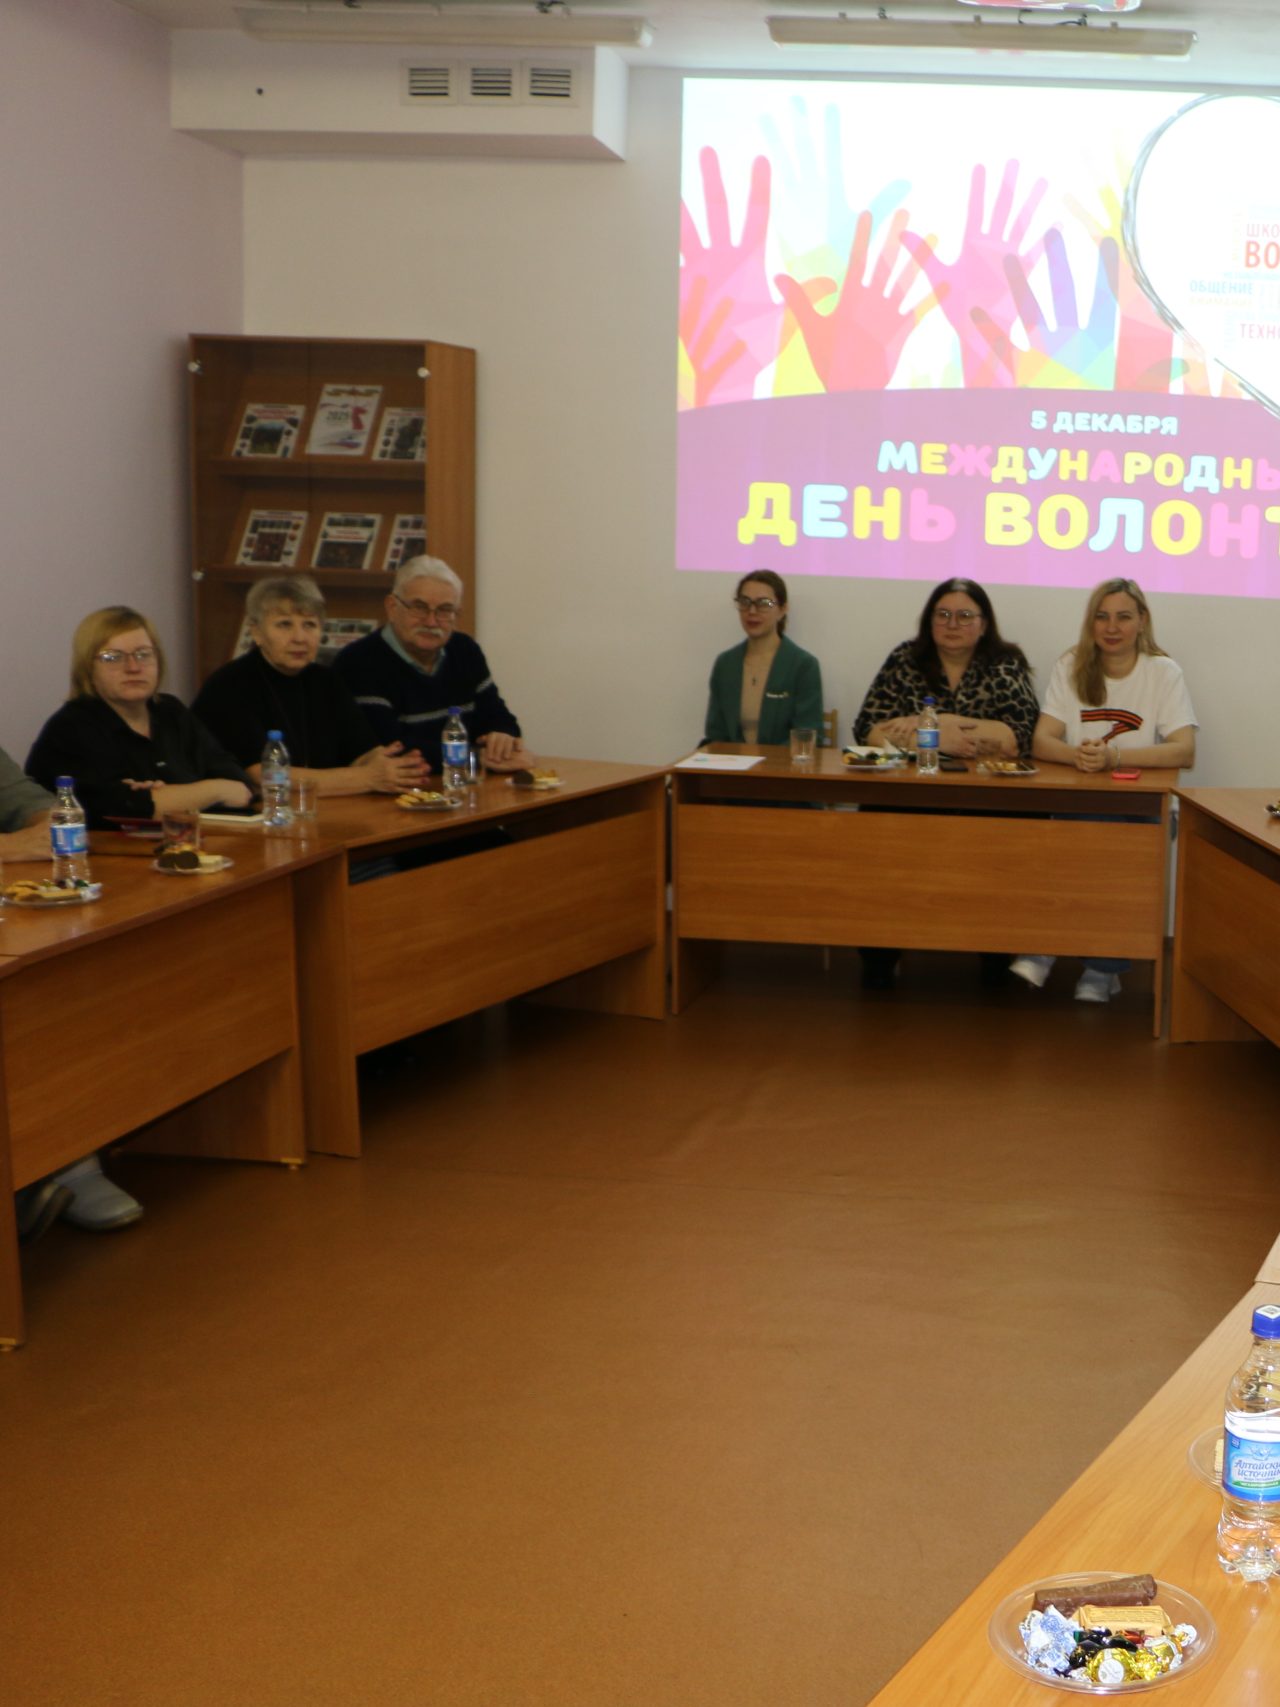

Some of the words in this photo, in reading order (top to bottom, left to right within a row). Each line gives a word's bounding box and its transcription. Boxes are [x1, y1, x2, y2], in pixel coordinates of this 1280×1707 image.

[1189, 279, 1254, 296] ОБЩЕНИЕ
[1030, 410, 1047, 430] 5
[1053, 411, 1178, 437] ДЕКАБРЯ
[737, 482, 957, 548] ДЕНЬ
